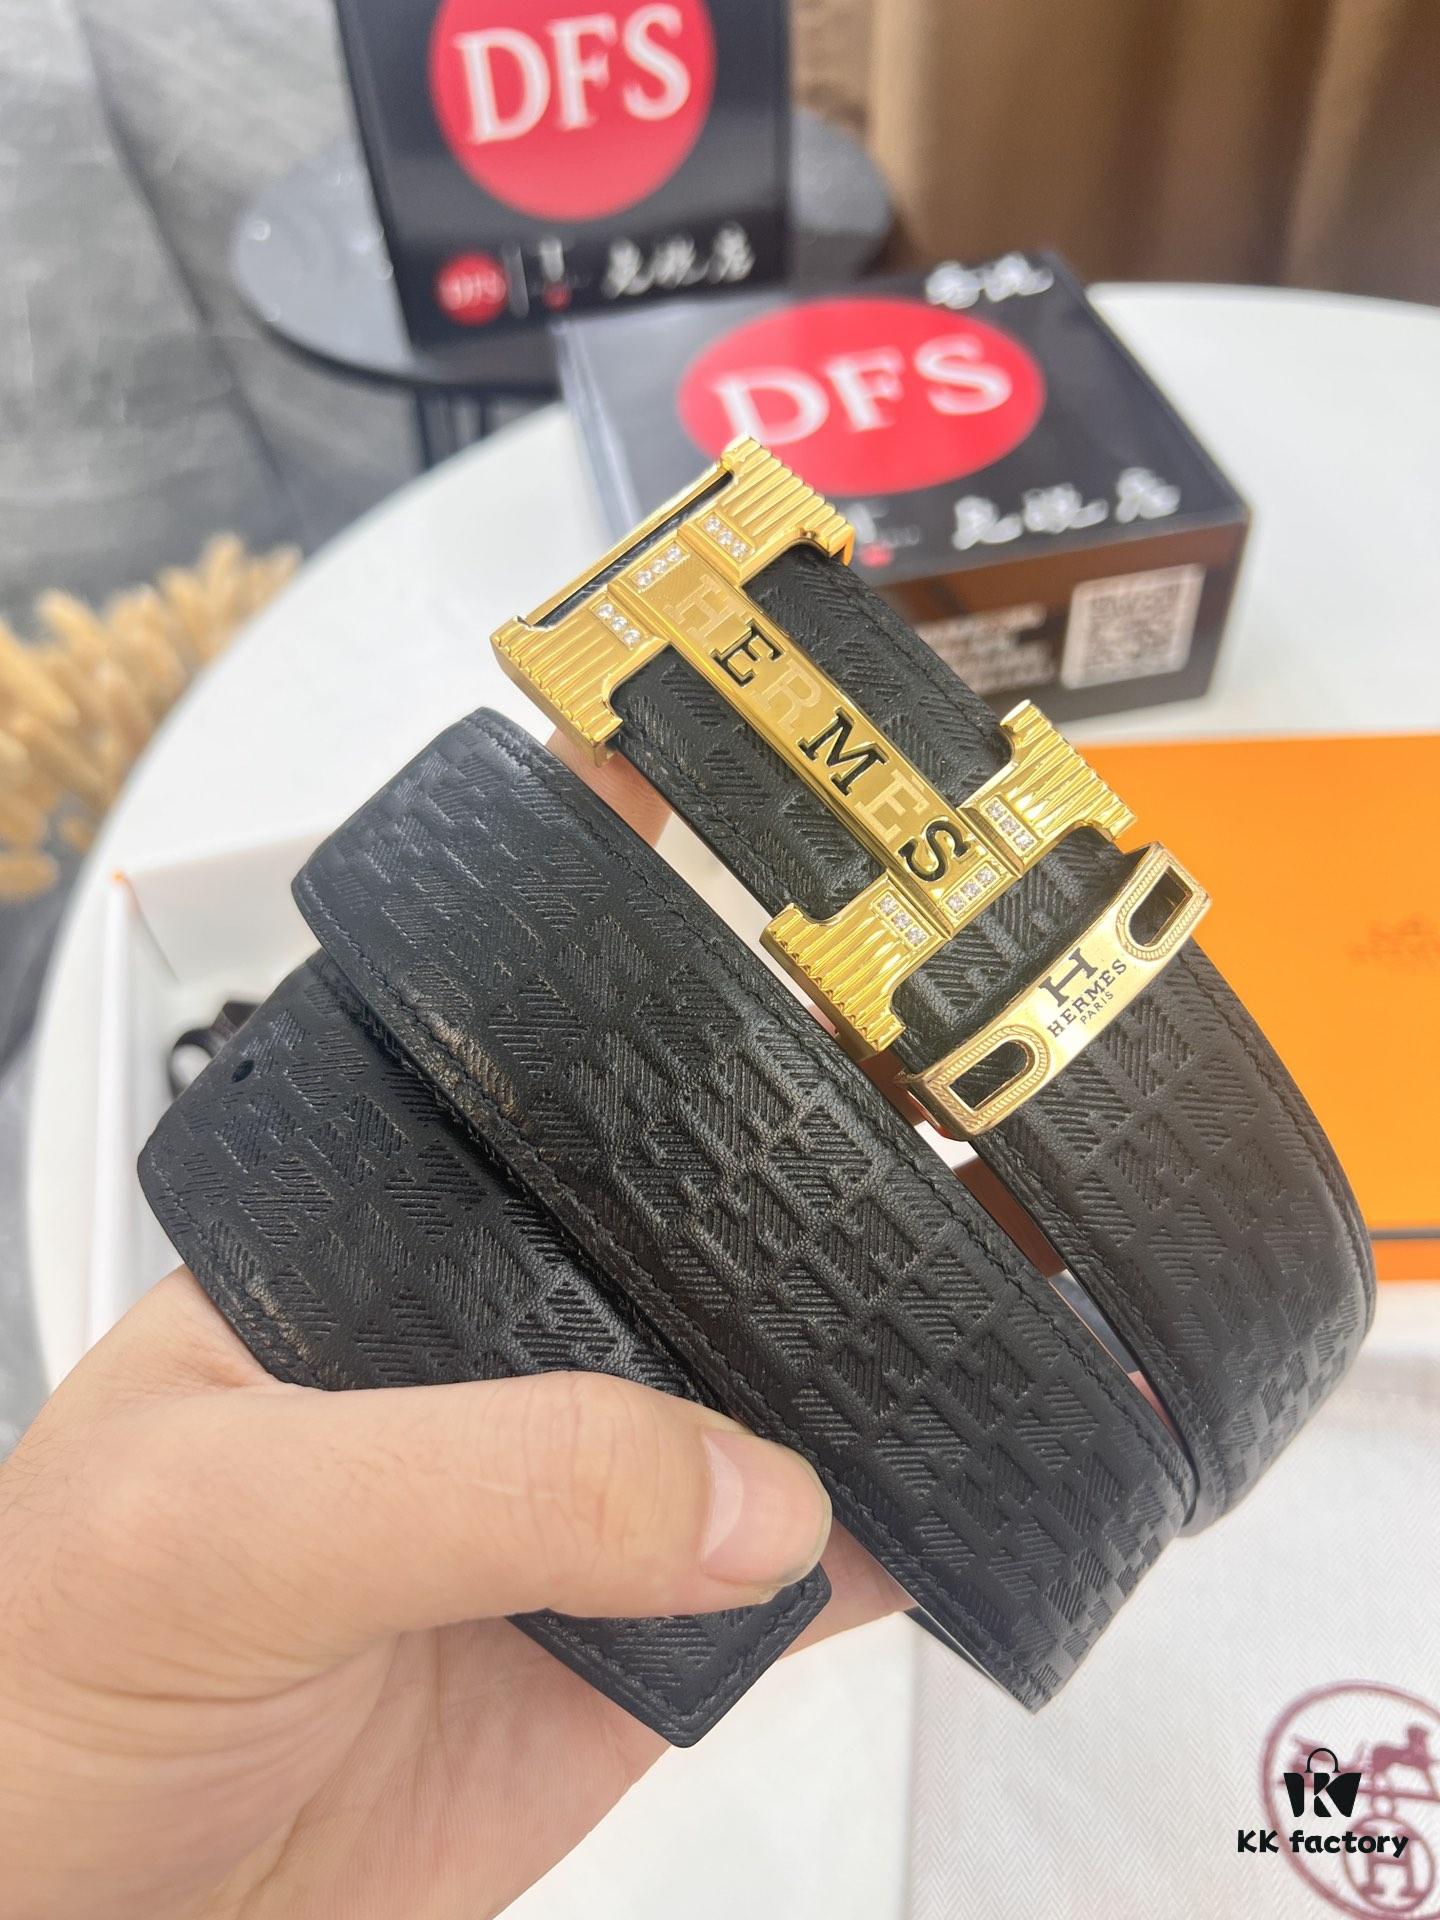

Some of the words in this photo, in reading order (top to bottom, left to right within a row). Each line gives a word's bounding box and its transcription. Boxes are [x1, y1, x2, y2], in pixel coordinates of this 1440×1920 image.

[452, 2, 692, 145] DFS
[712, 333, 1013, 446] DFS
[662, 572, 972, 882] HERMES
[1039, 947, 1098, 1008] H
[1046, 958, 1127, 1038] HERMES
[1079, 991, 1114, 1024] PARIS
